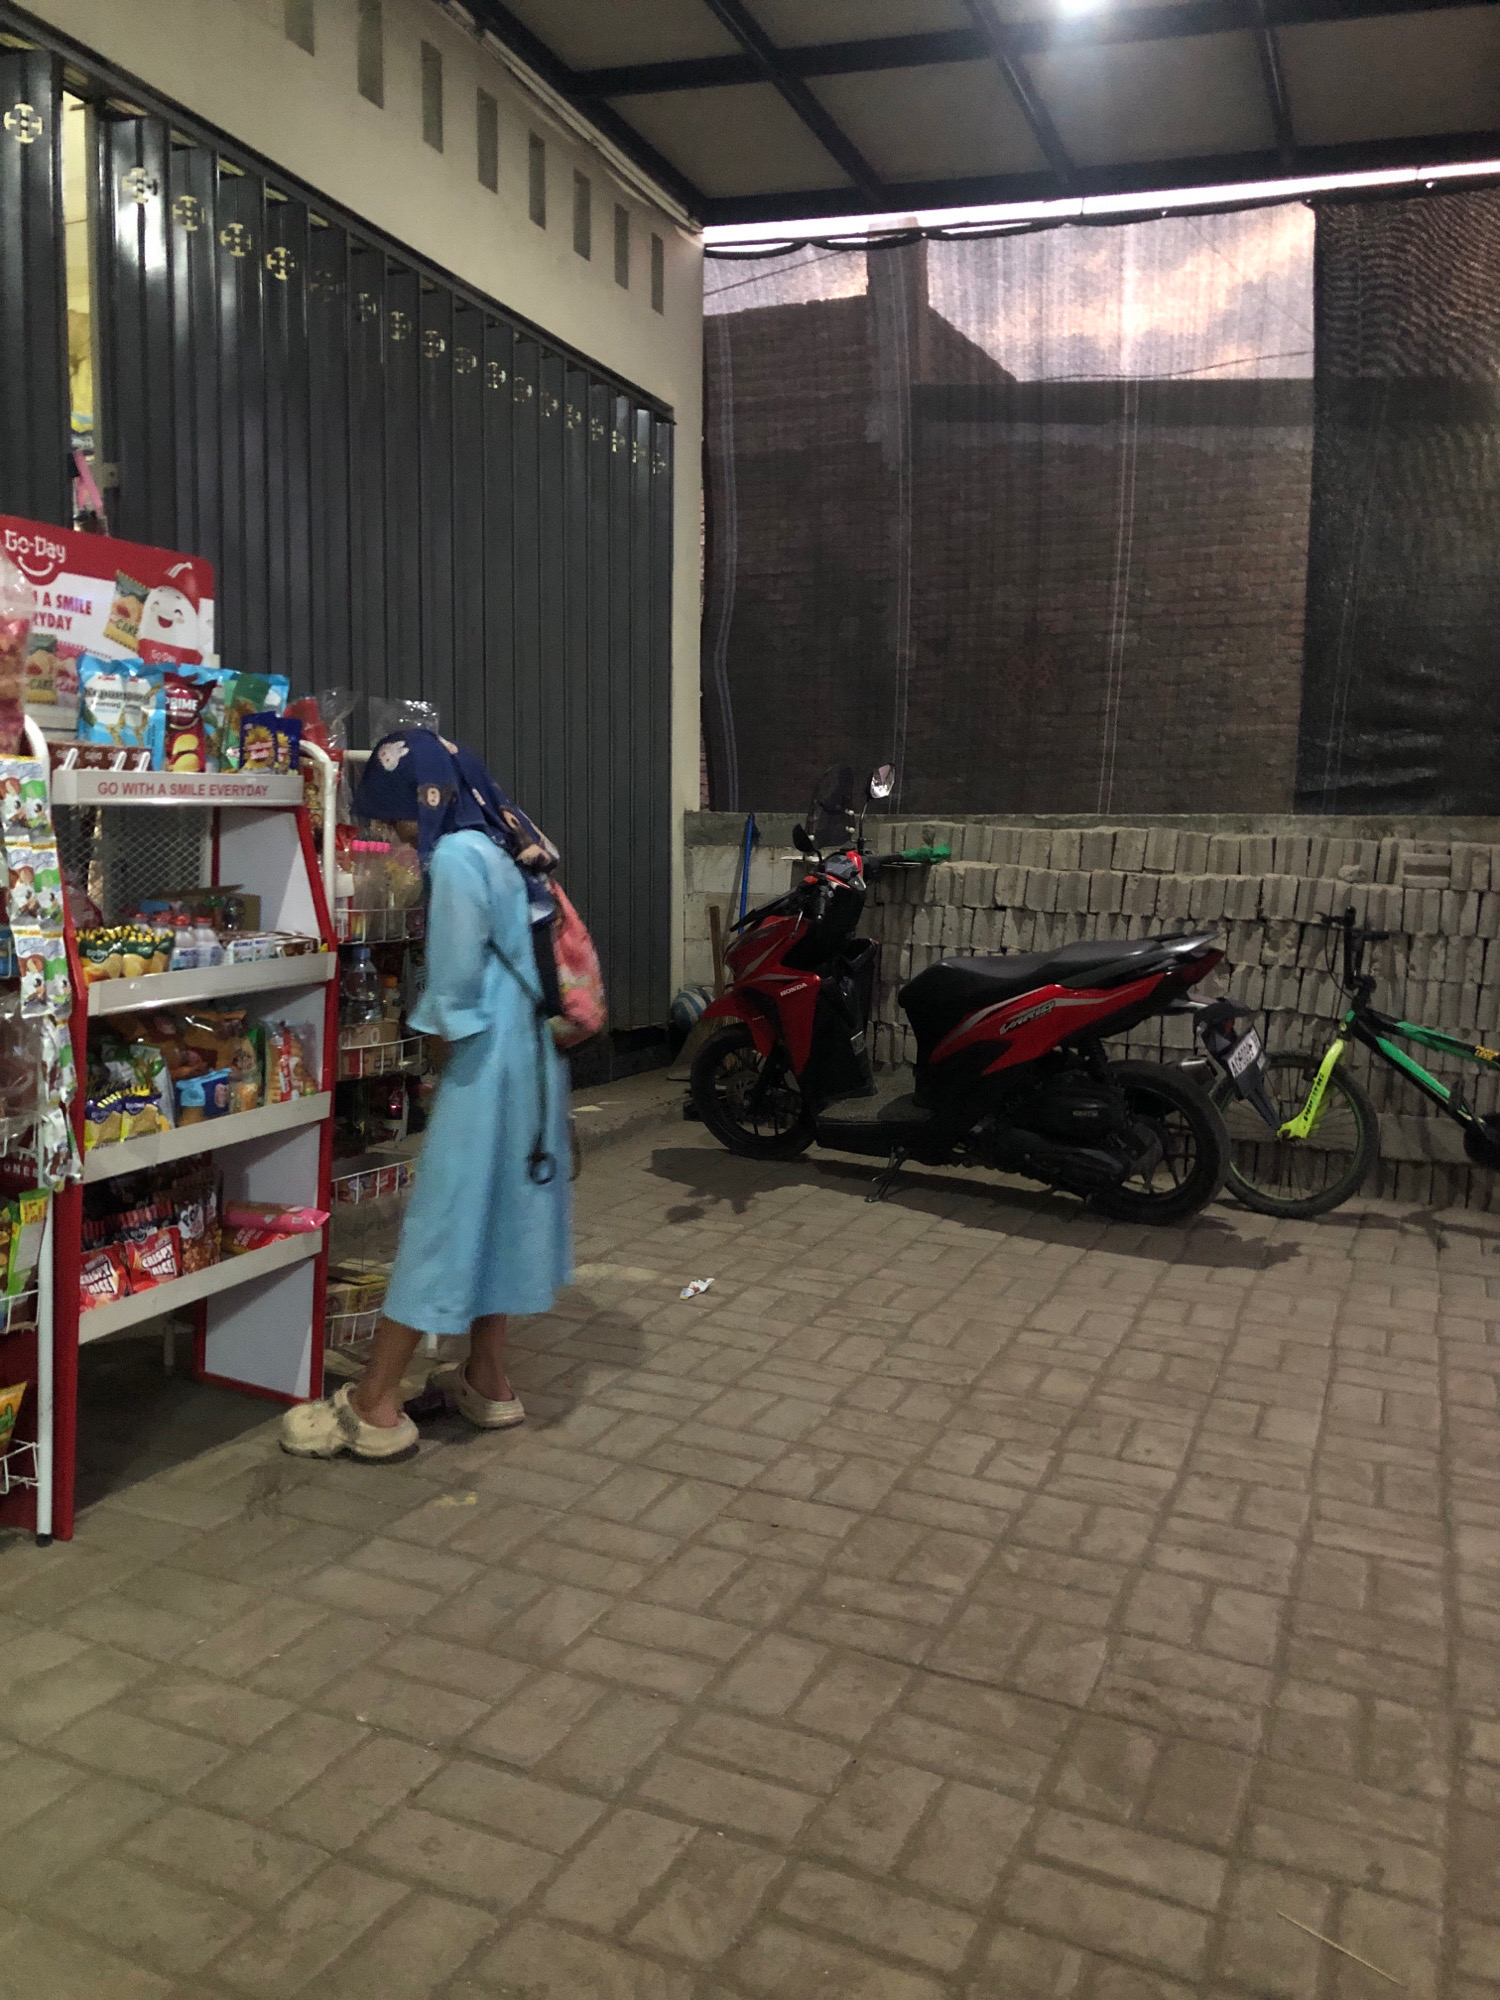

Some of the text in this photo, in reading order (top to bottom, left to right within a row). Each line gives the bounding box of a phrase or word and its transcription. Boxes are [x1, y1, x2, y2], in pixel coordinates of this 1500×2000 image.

[5, 529, 66, 564] Go-Day
[43, 591, 52, 607] A
[56, 594, 92, 616] SMILE
[33, 612, 73, 631] RYDAY
[98, 782, 268, 797] GO WITH A SMILE EVERYDAY
[780, 983, 807, 996] HONDA
[141, 1244, 173, 1269] CRISPY
[151, 1260, 175, 1276] RICE
[88, 1278, 113, 1294] RICE
